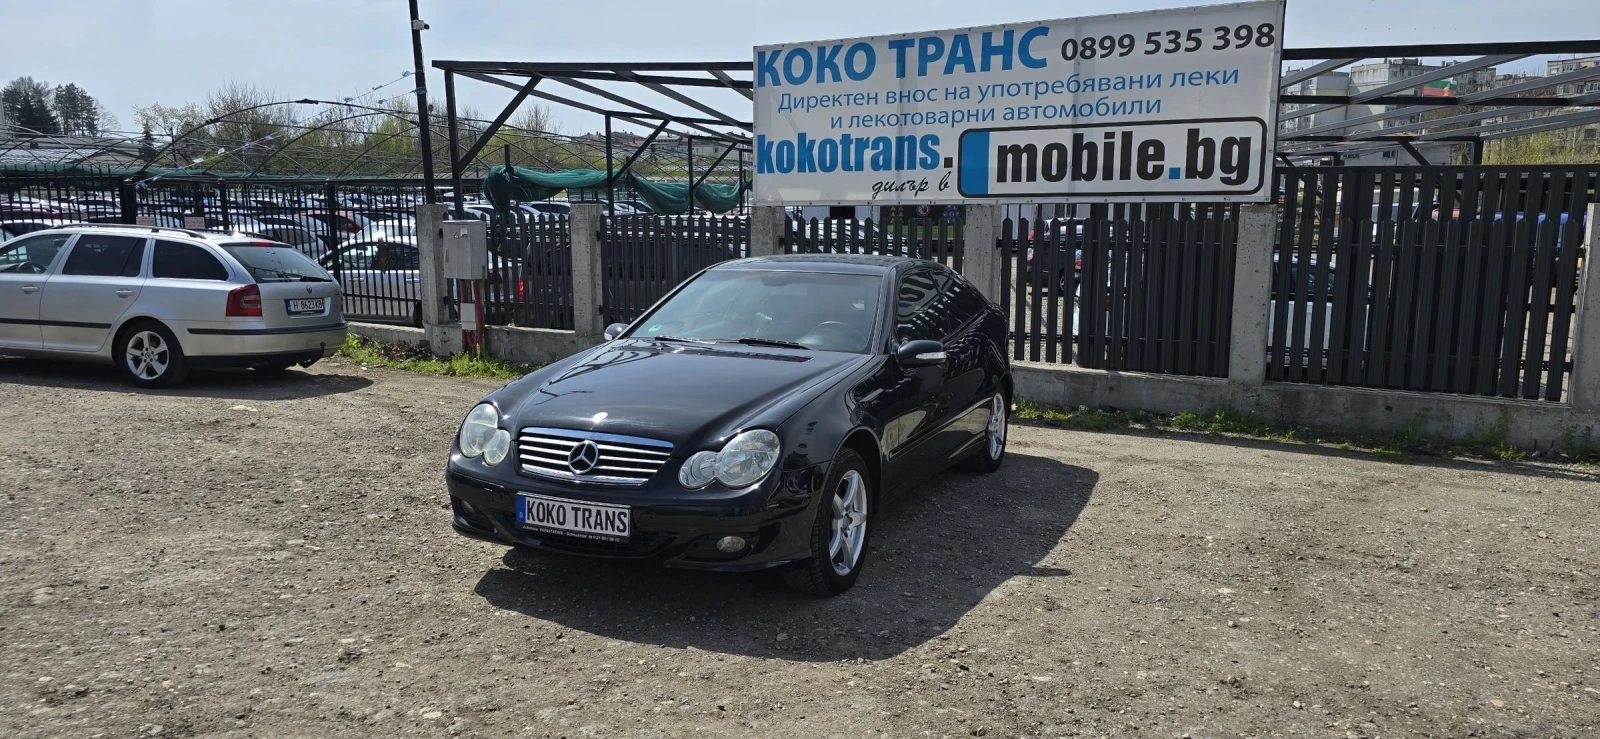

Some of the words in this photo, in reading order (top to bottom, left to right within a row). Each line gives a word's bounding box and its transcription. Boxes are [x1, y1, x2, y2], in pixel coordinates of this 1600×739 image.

[756, 42, 876, 88] КОКО
[888, 26, 1050, 79] ТРАНС
[1061, 33, 1135, 62] 0899
[1144, 28, 1203, 56] 535
[1212, 22, 1275, 51] 398
[778, 91, 879, 114] Директен
[885, 86, 938, 105] внос
[944, 84, 971, 101] на
[977, 73, 1162, 104] употребявани
[1169, 68, 1239, 88] леки
[830, 115, 843, 129] и
[847, 105, 996, 130] лекотоварни
[1002, 97, 1162, 122] автомобили
[996, 128, 1252, 186] mobile.bg
[871, 176, 930, 200] дилър
[527, 500, 566, 526] KOKO
[571, 506, 627, 534] TRANS
